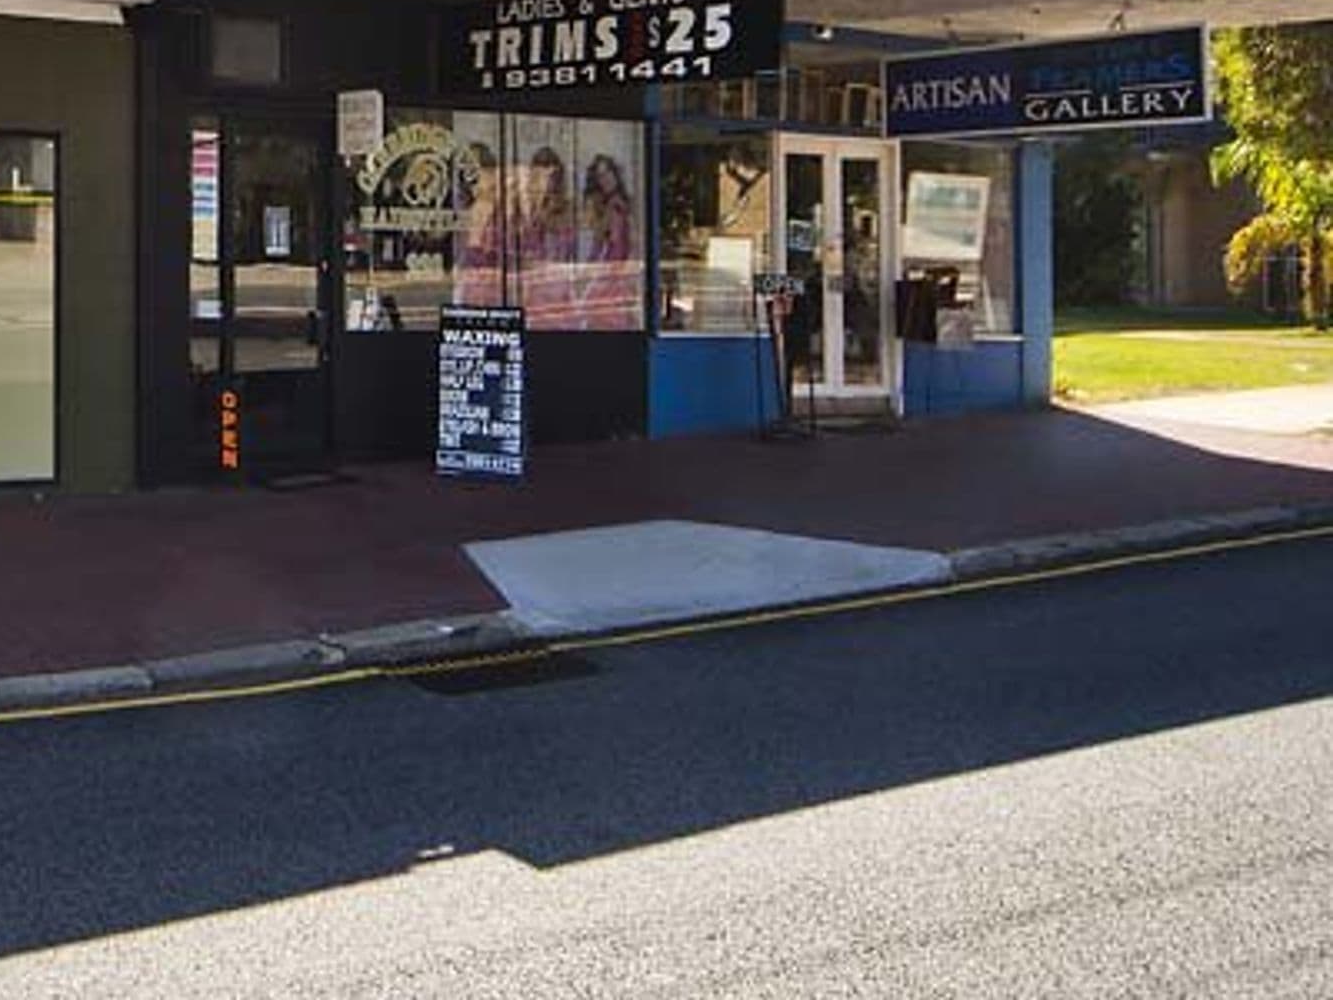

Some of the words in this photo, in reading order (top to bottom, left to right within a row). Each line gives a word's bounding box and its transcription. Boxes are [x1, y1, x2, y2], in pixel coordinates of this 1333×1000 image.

[470, 16, 617, 69] TRIMS
[891, 74, 1012, 112] ARTISAN
[1024, 89, 1194, 121] GALLERY
